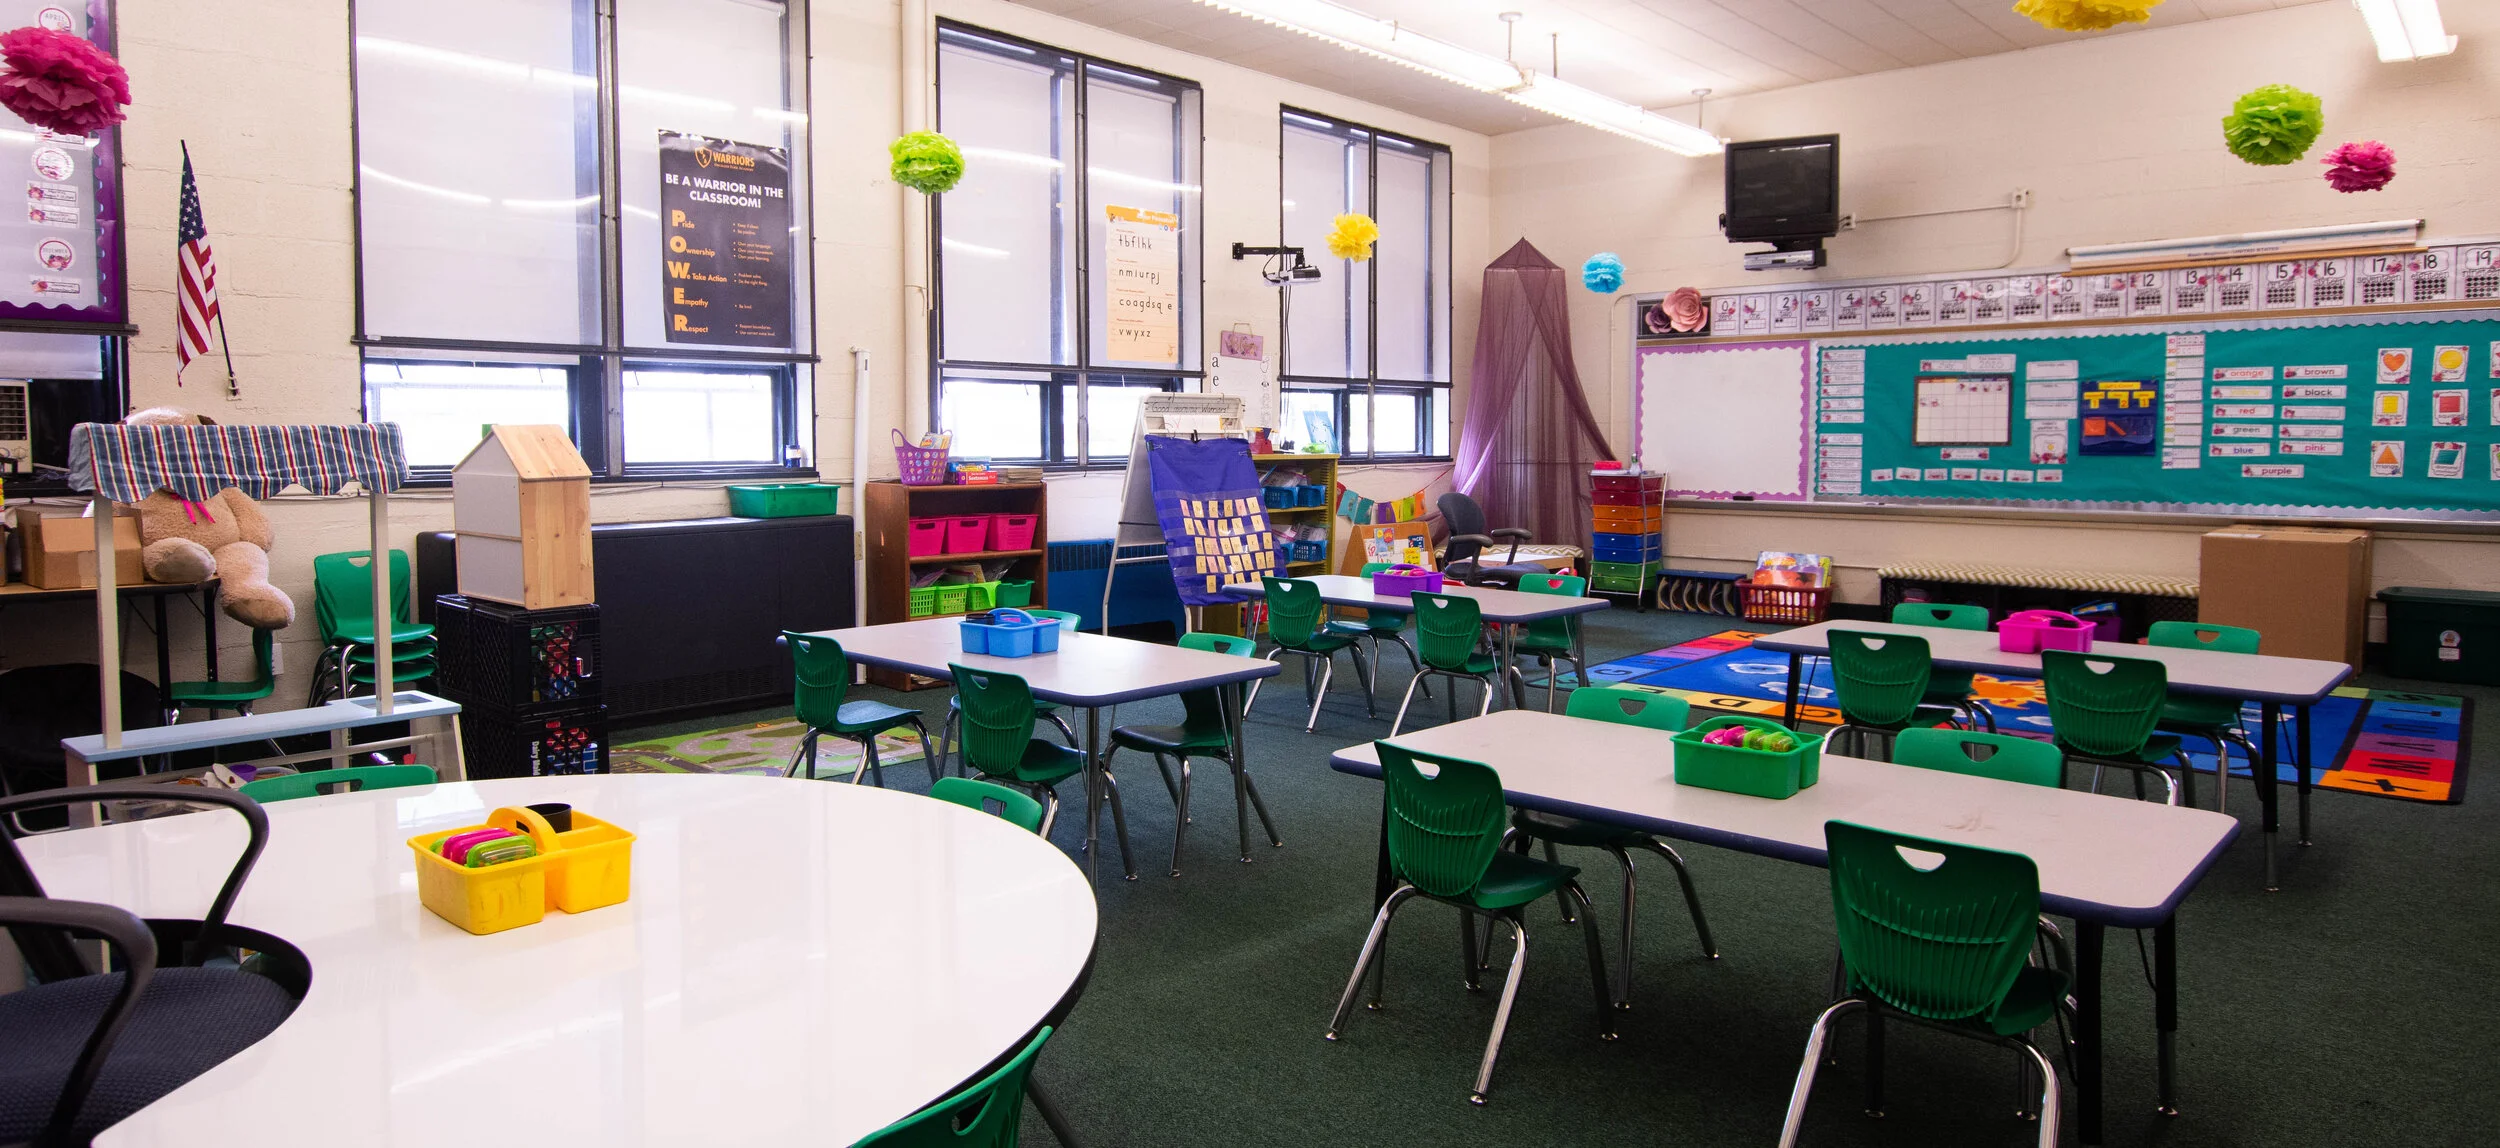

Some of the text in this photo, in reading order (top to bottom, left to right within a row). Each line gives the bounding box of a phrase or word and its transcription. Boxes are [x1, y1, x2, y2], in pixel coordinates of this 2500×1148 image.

[713, 152, 755, 167] WARRIORS
[665, 174, 784, 198] BE A WARRIOR IN THE
[689, 190, 761, 208] CLASSROOM!
[671, 209, 695, 229] Pride
[669, 235, 716, 258] Ownership
[2372, 258, 2386, 272] 17
[2424, 254, 2438, 270] 18
[2476, 250, 2492, 266] 19
[667, 260, 728, 283] We Take Action
[2229, 267, 2244, 281] 14
[2276, 265, 2288, 279] 15
[2324, 262, 2336, 276] 16
[2142, 274, 2154, 287] 12
[2186, 270, 2198, 284] 13
[1950, 286, 1958, 299] 7
[2062, 279, 2072, 292] 10
[673, 287, 709, 308] Empathy
[1814, 295, 1821, 306] 3
[1846, 293, 1854, 304] 4
[1880, 290, 1887, 302] 5
[1914, 288, 1922, 300] 6
[1722, 300, 1729, 312] 0
[1782, 296, 1790, 309] 2
[674, 314, 709, 334] Respect
[1212, 356, 1220, 368] a
[1212, 375, 1220, 386] e
[2304, 444, 2326, 452] pink
[2262, 467, 2292, 475] purple
[1710, 698, 1752, 708] D
[2388, 708, 2442, 717] T
[531, 740, 539, 759] Dairy
[2377, 741, 2436, 752] V
[2368, 758, 2432, 775] W
